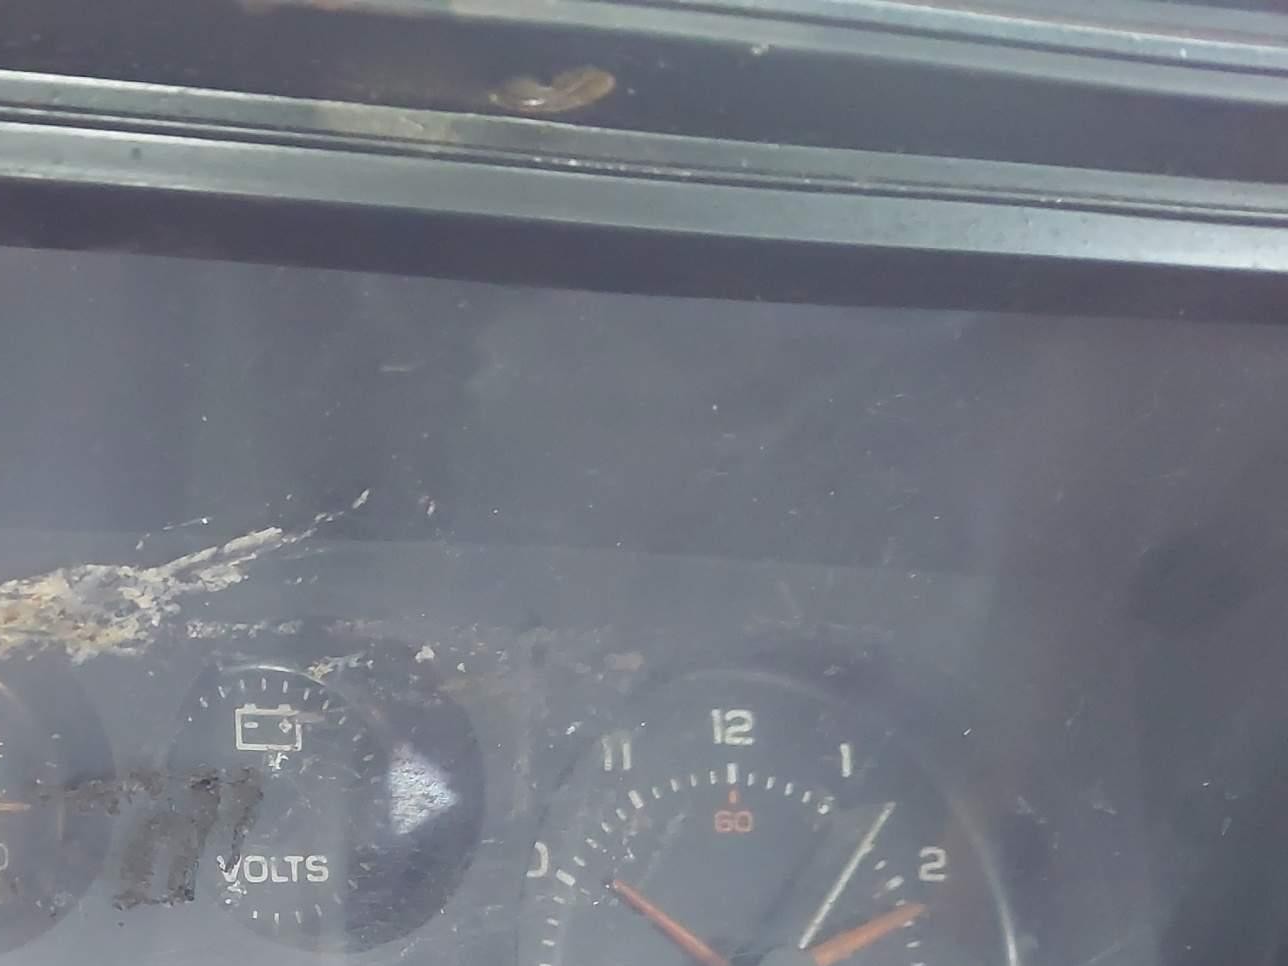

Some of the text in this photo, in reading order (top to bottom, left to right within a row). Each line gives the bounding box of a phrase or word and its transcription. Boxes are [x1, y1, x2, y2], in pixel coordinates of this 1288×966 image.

[711, 709, 754, 745] 12
[840, 743, 851, 777] 1
[714, 810, 754, 833] 60
[216, 855, 329, 883] VOLTS
[919, 847, 947, 882] 2
